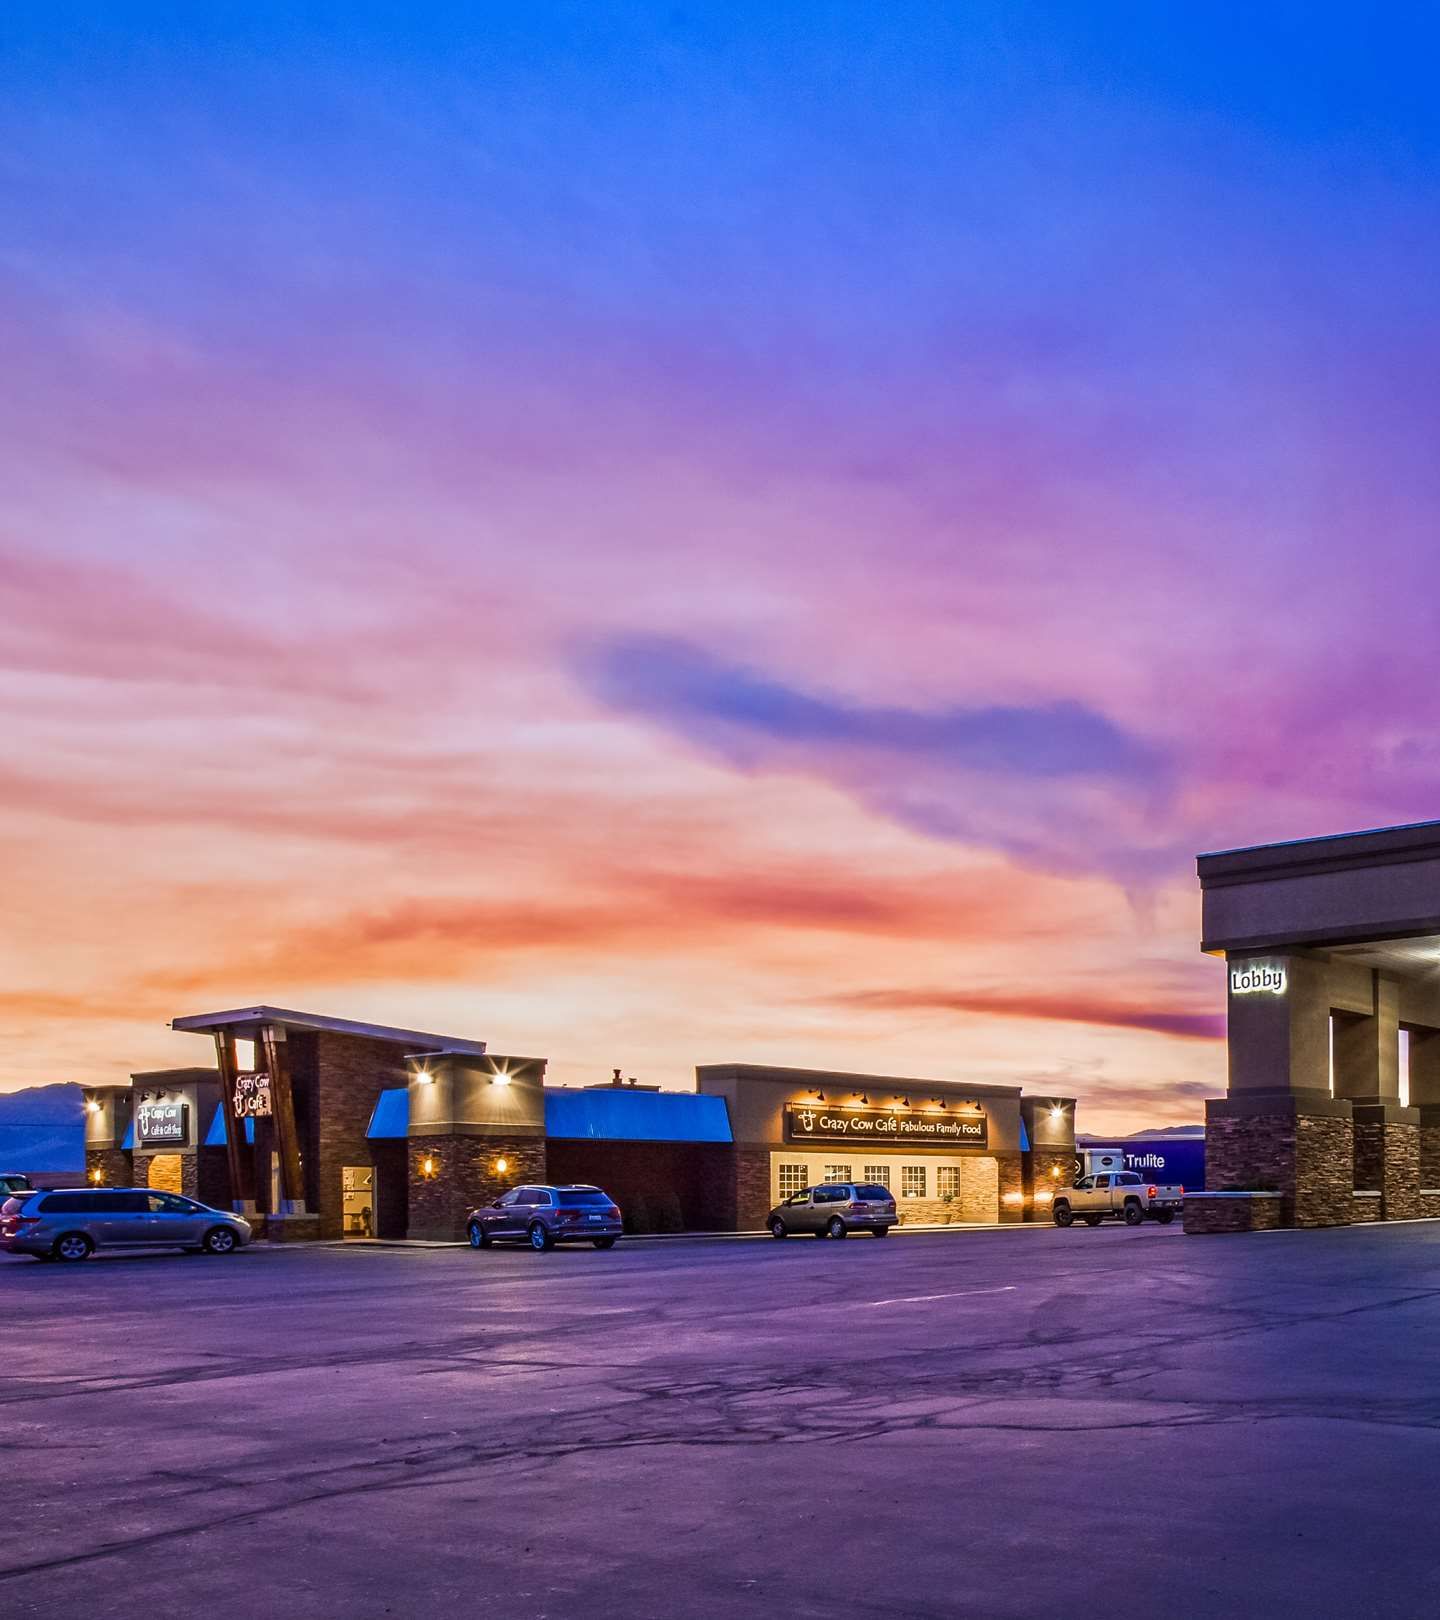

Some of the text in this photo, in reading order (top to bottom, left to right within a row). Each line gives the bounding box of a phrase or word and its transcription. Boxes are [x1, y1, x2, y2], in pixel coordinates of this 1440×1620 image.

[1232, 969, 1282, 990] Lobby
[236, 1075, 270, 1092] Crazy Cow
[820, 1116, 982, 1136] Crazy Cow Café Fabulous Family Food
[1126, 1154, 1165, 1168] Trulite
